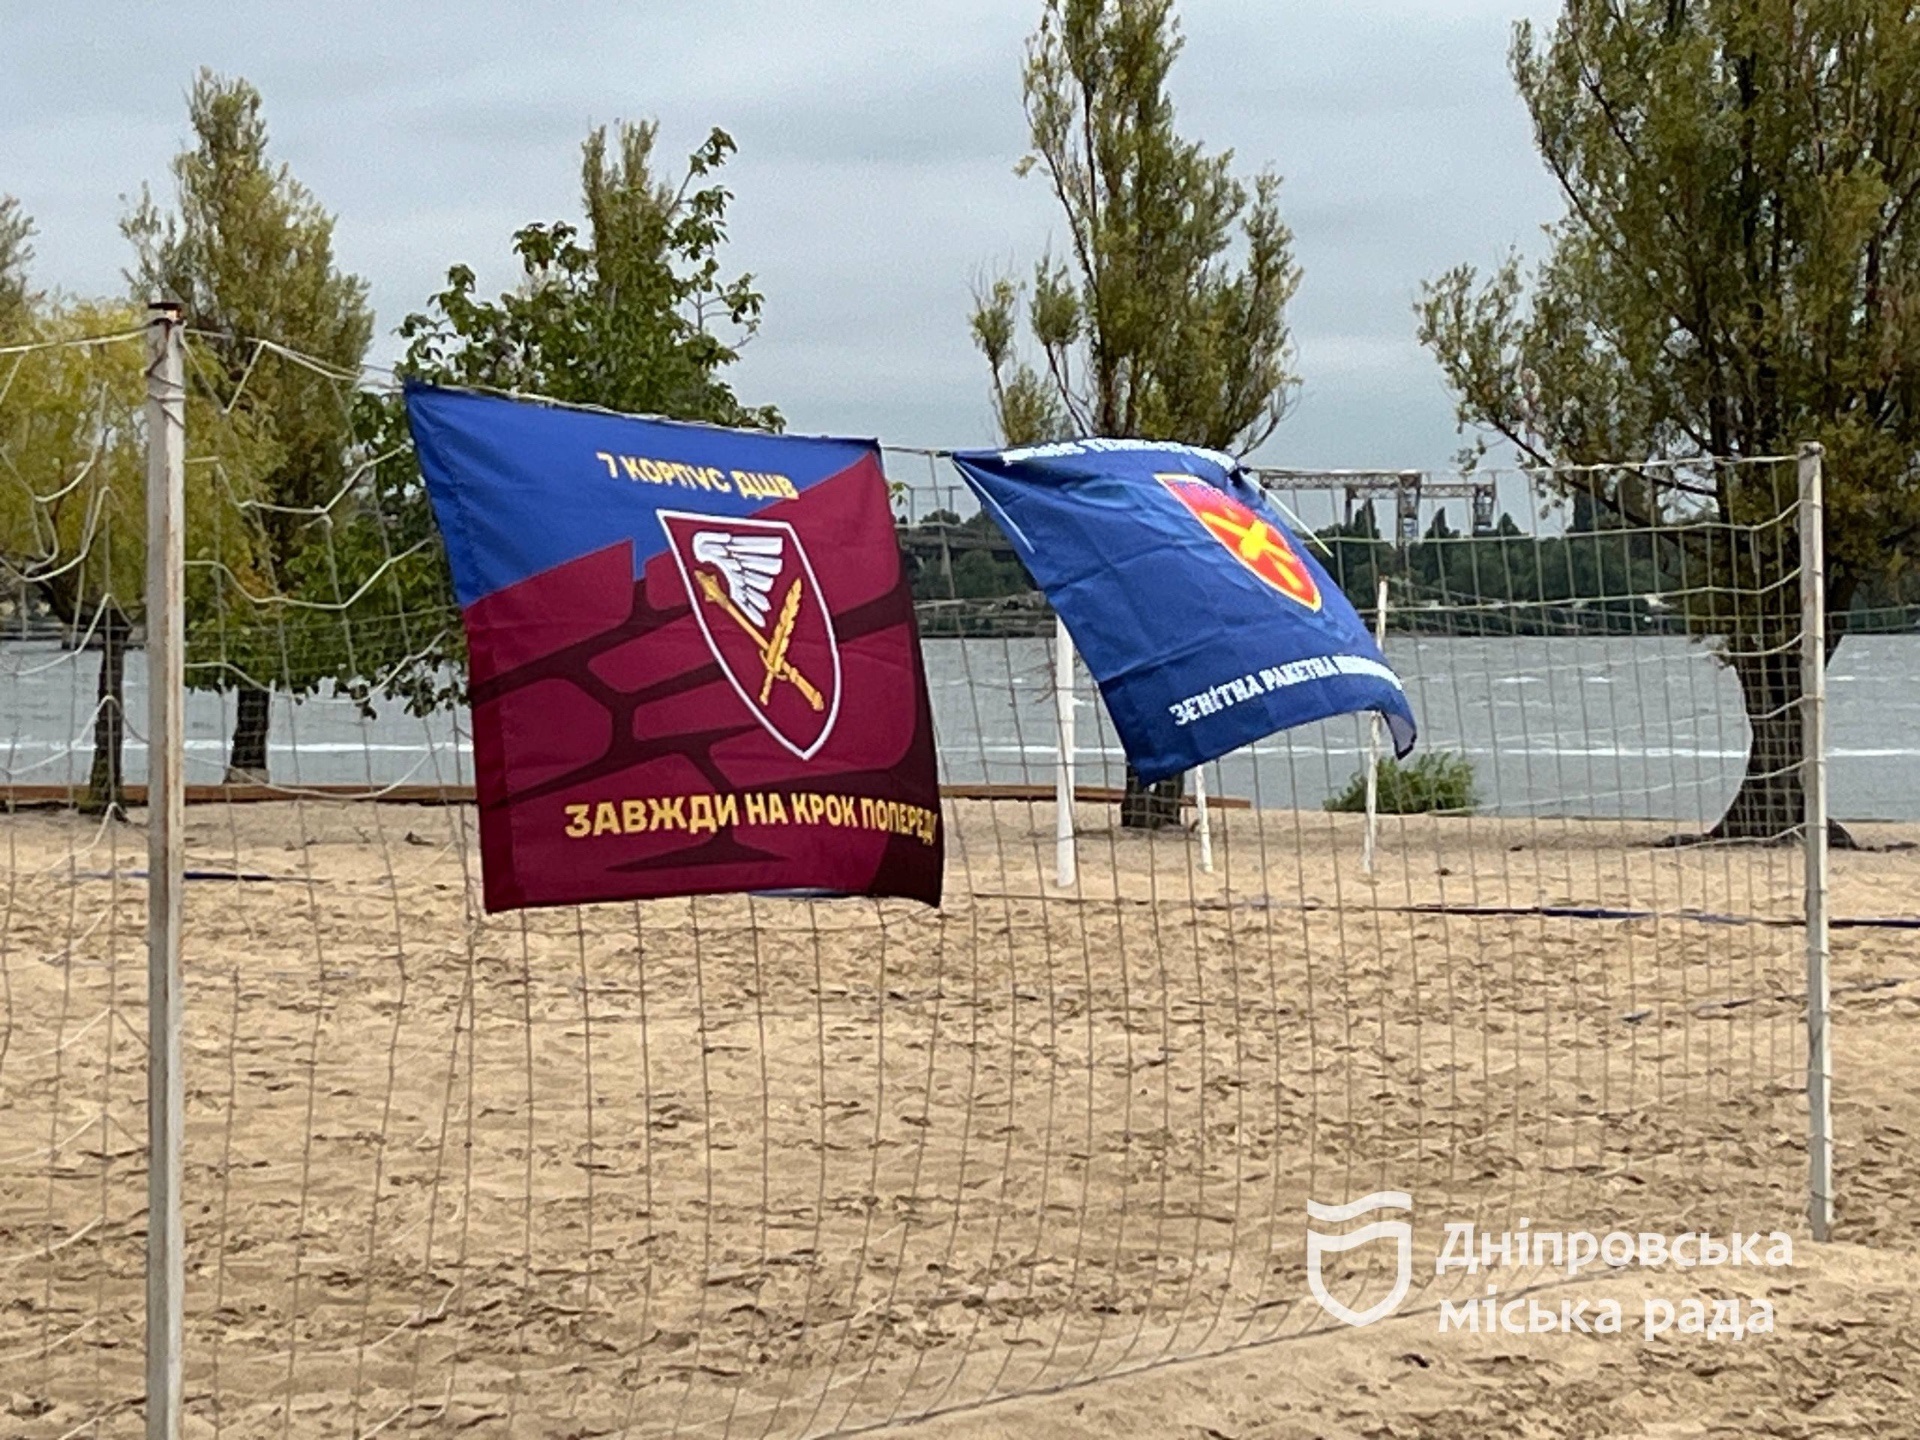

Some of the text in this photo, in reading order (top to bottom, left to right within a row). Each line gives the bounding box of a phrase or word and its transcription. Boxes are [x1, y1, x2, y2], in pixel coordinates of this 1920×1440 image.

[596, 452, 799, 500] 7 КОРПУС ДШВ
[564, 794, 739, 838] ЗАВЖДИ
[745, 792, 788, 825] НА
[789, 792, 859, 828] КРОК
